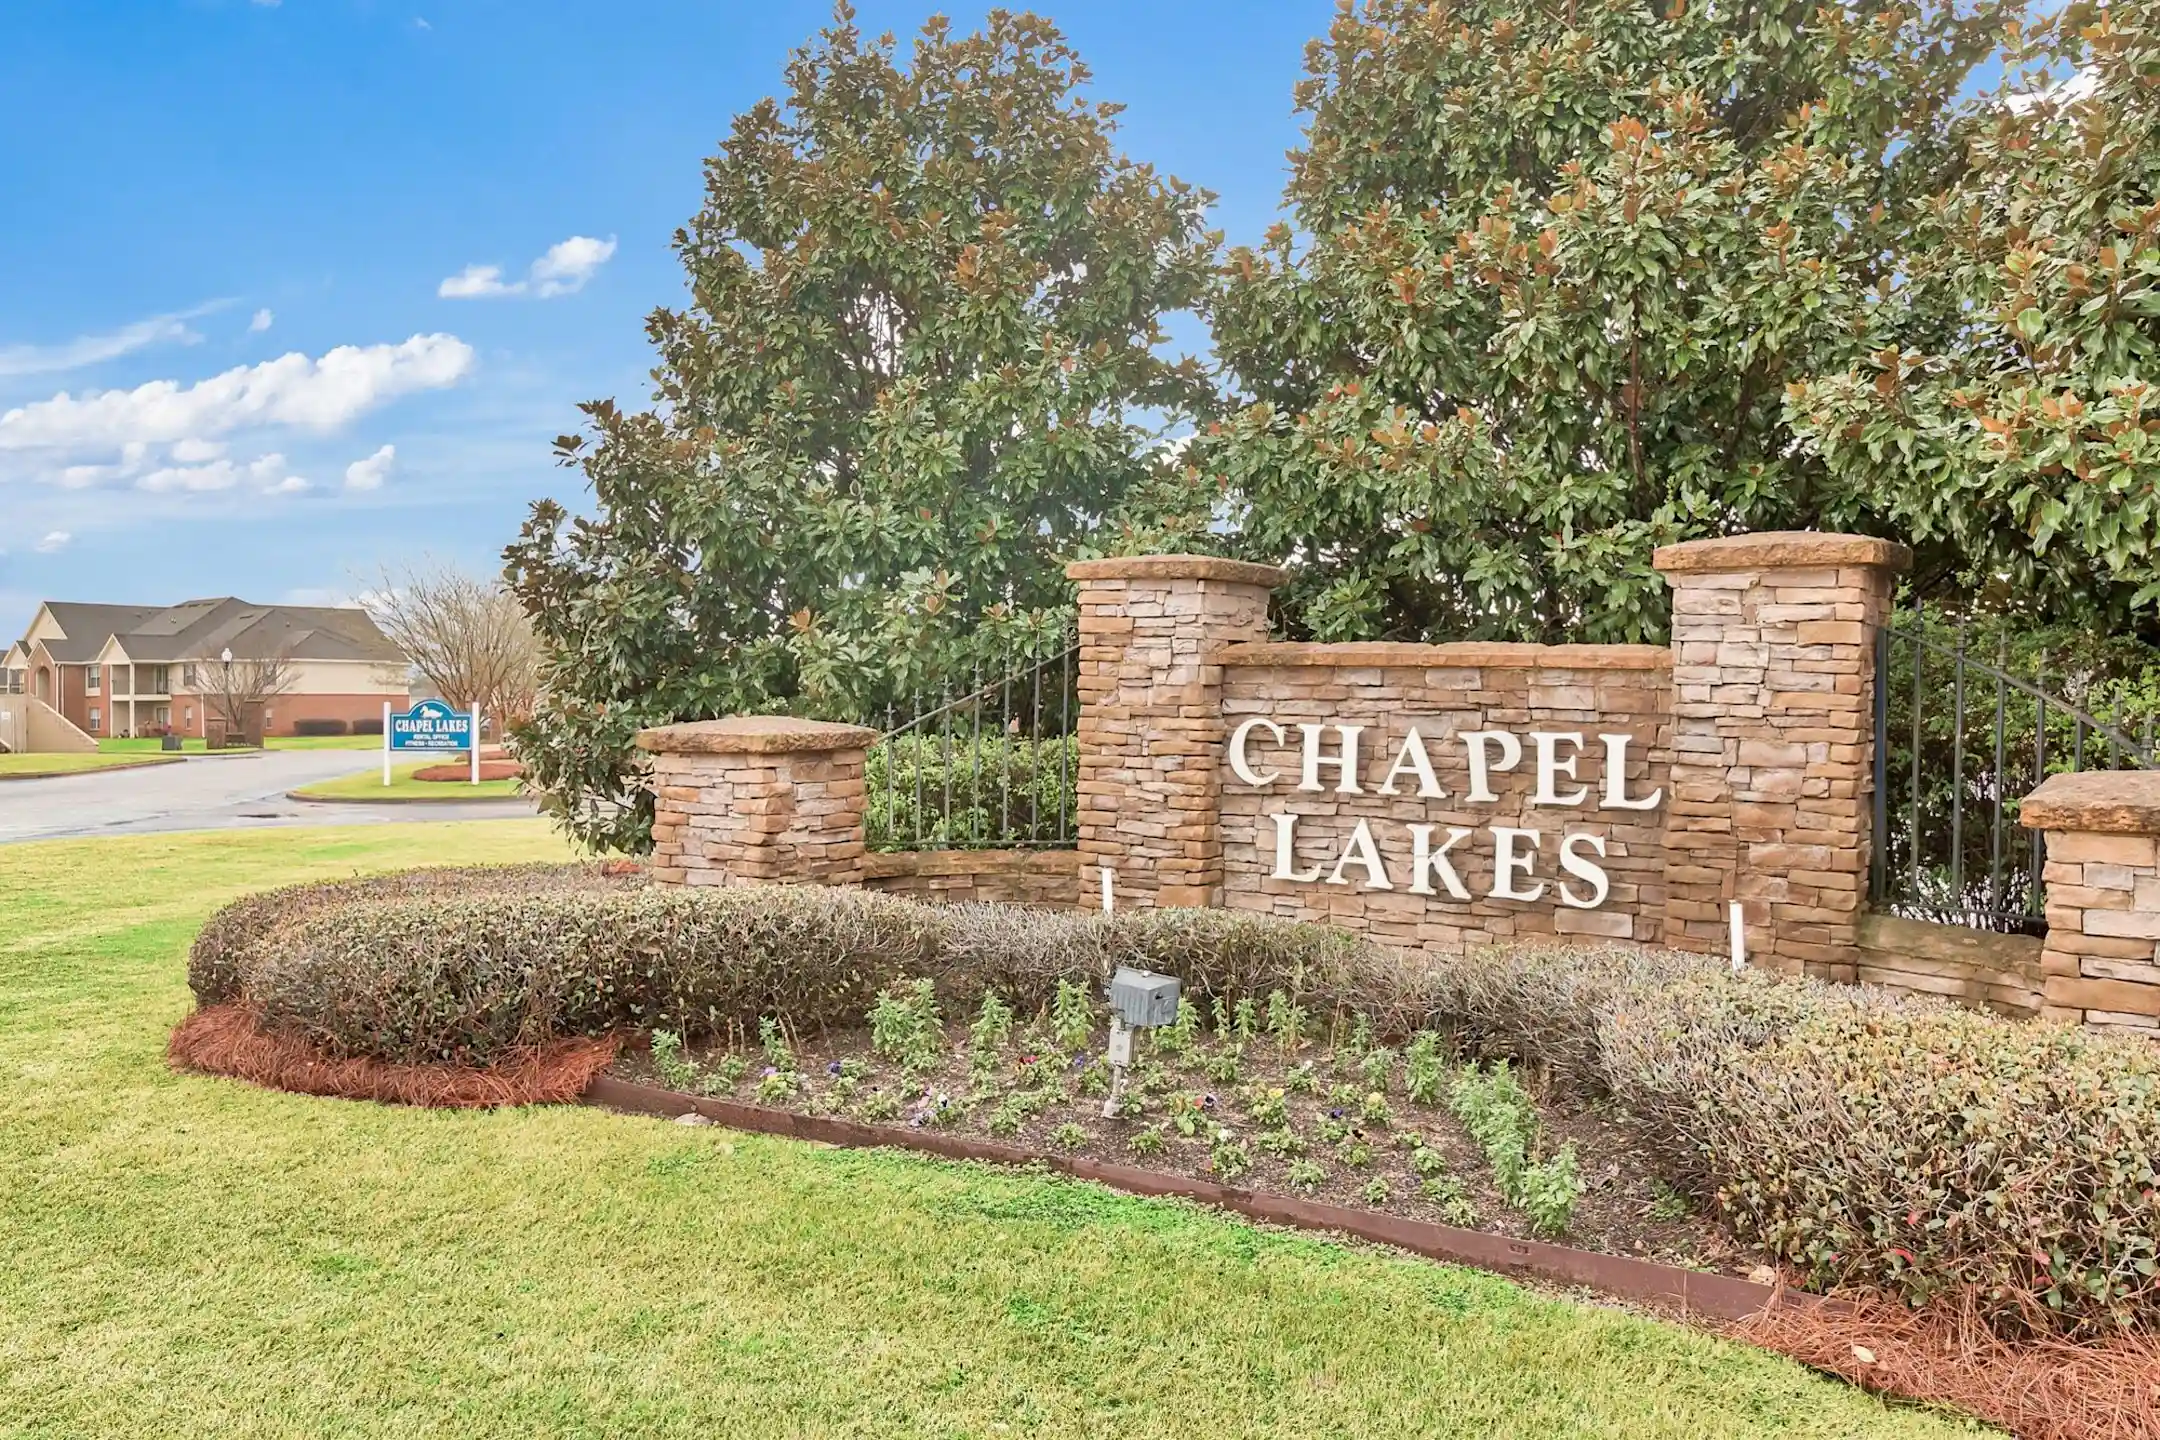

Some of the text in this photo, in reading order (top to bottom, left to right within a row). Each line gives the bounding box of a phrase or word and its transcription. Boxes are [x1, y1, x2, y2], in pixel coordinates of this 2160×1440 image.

[395, 719, 468, 733] CHAPEL LAKES
[1229, 718, 1662, 810] CHAPEL
[1270, 813, 1609, 909] LAKES
